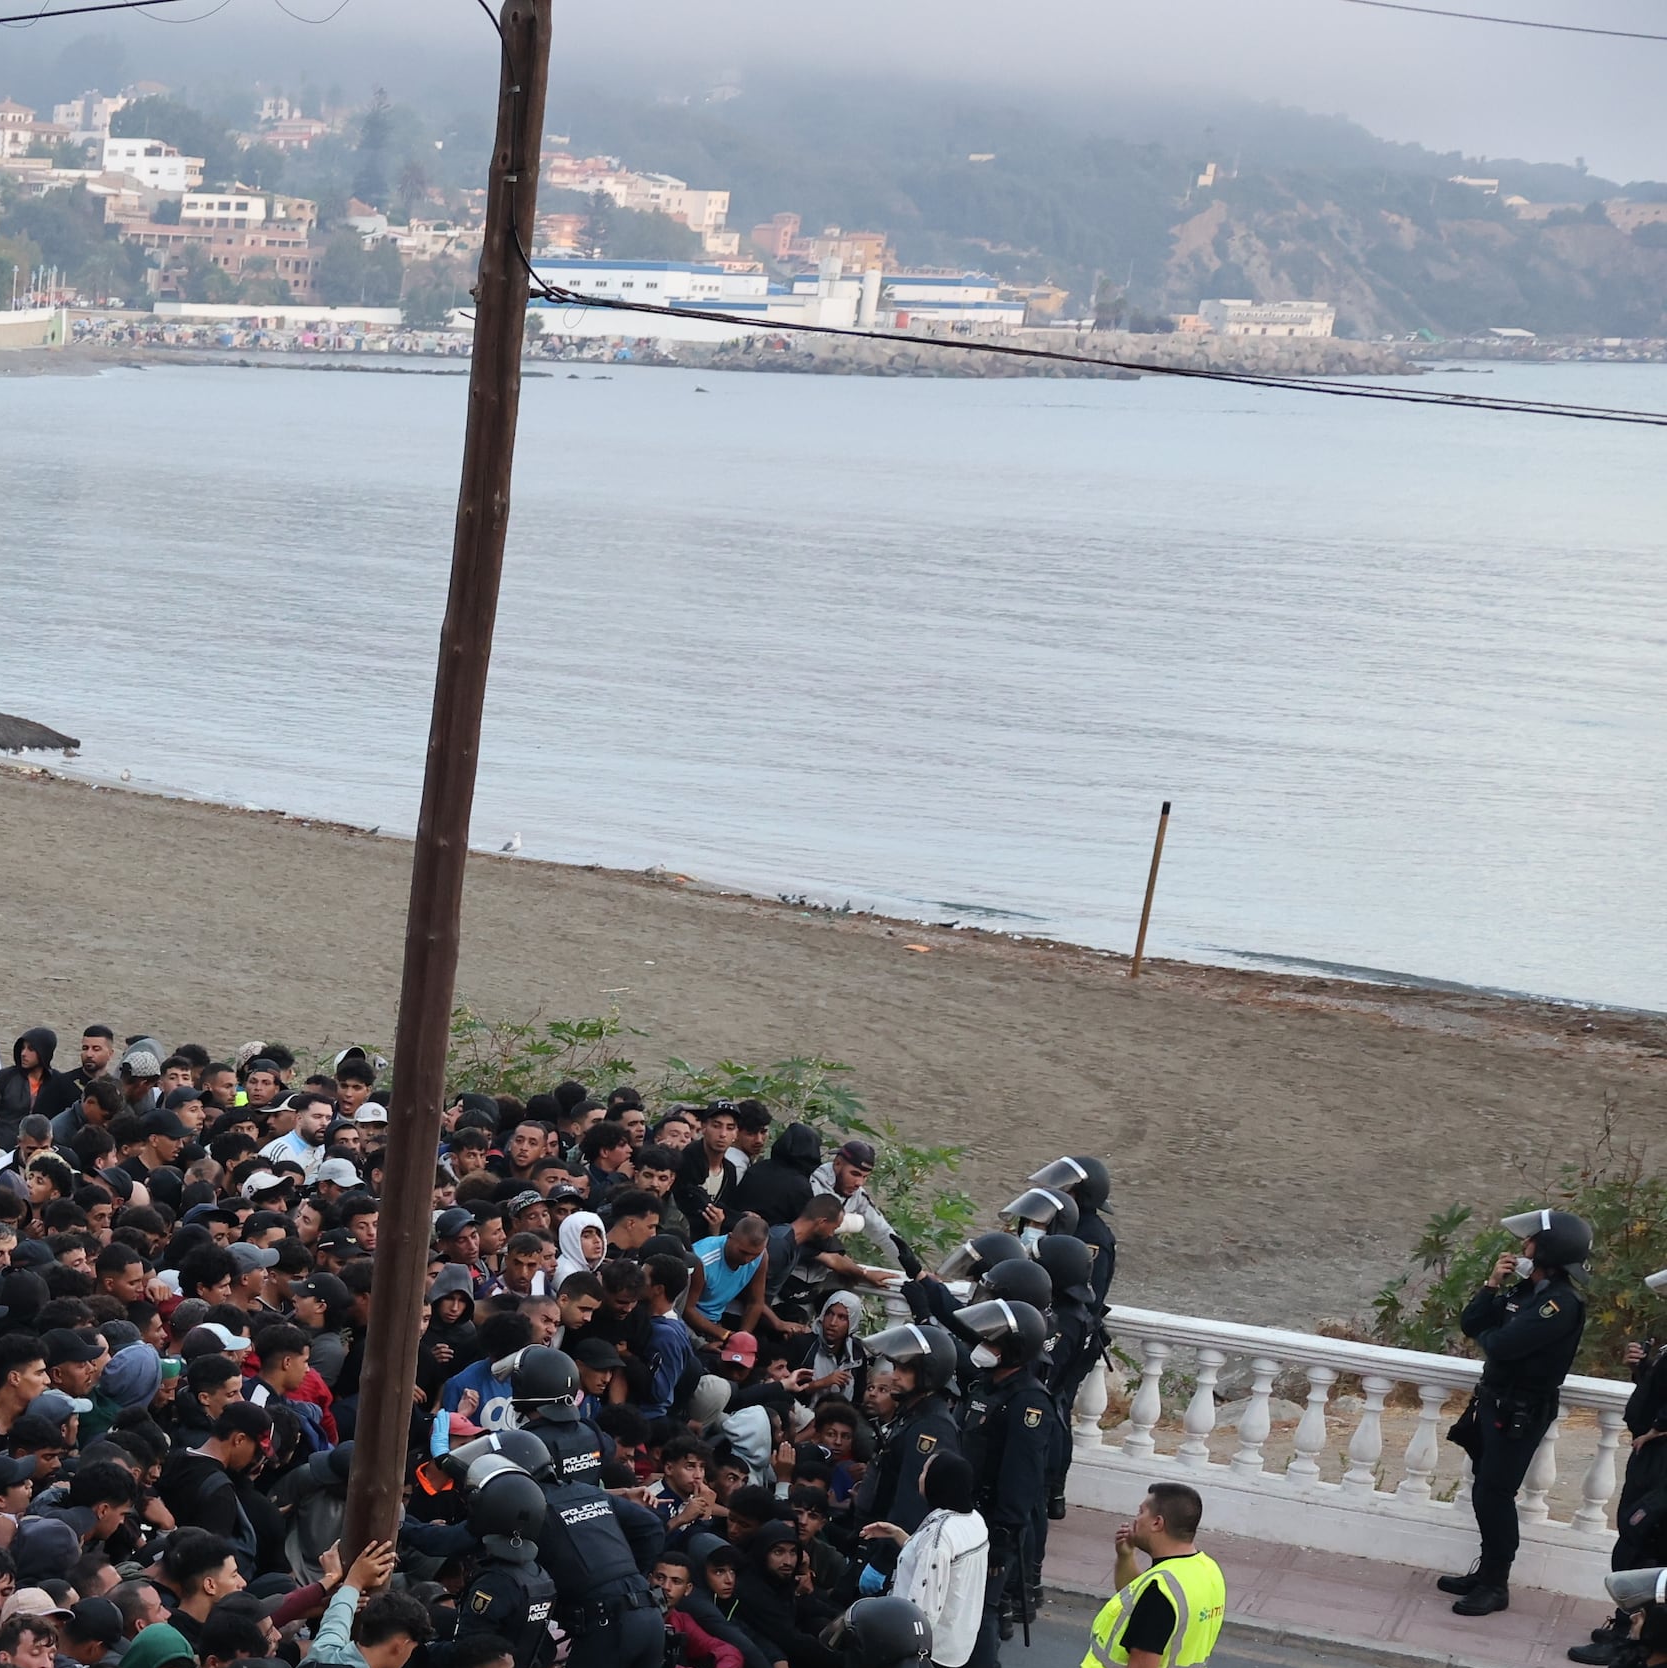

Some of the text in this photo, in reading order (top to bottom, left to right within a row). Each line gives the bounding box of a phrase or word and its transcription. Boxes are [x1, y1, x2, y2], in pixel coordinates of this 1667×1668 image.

[563, 1452, 594, 1467] POLICIA
[563, 1459, 602, 1475] NACIONAL
[560, 1502, 597, 1519] POLICIA
[565, 1506, 614, 1526] NACIONAL
